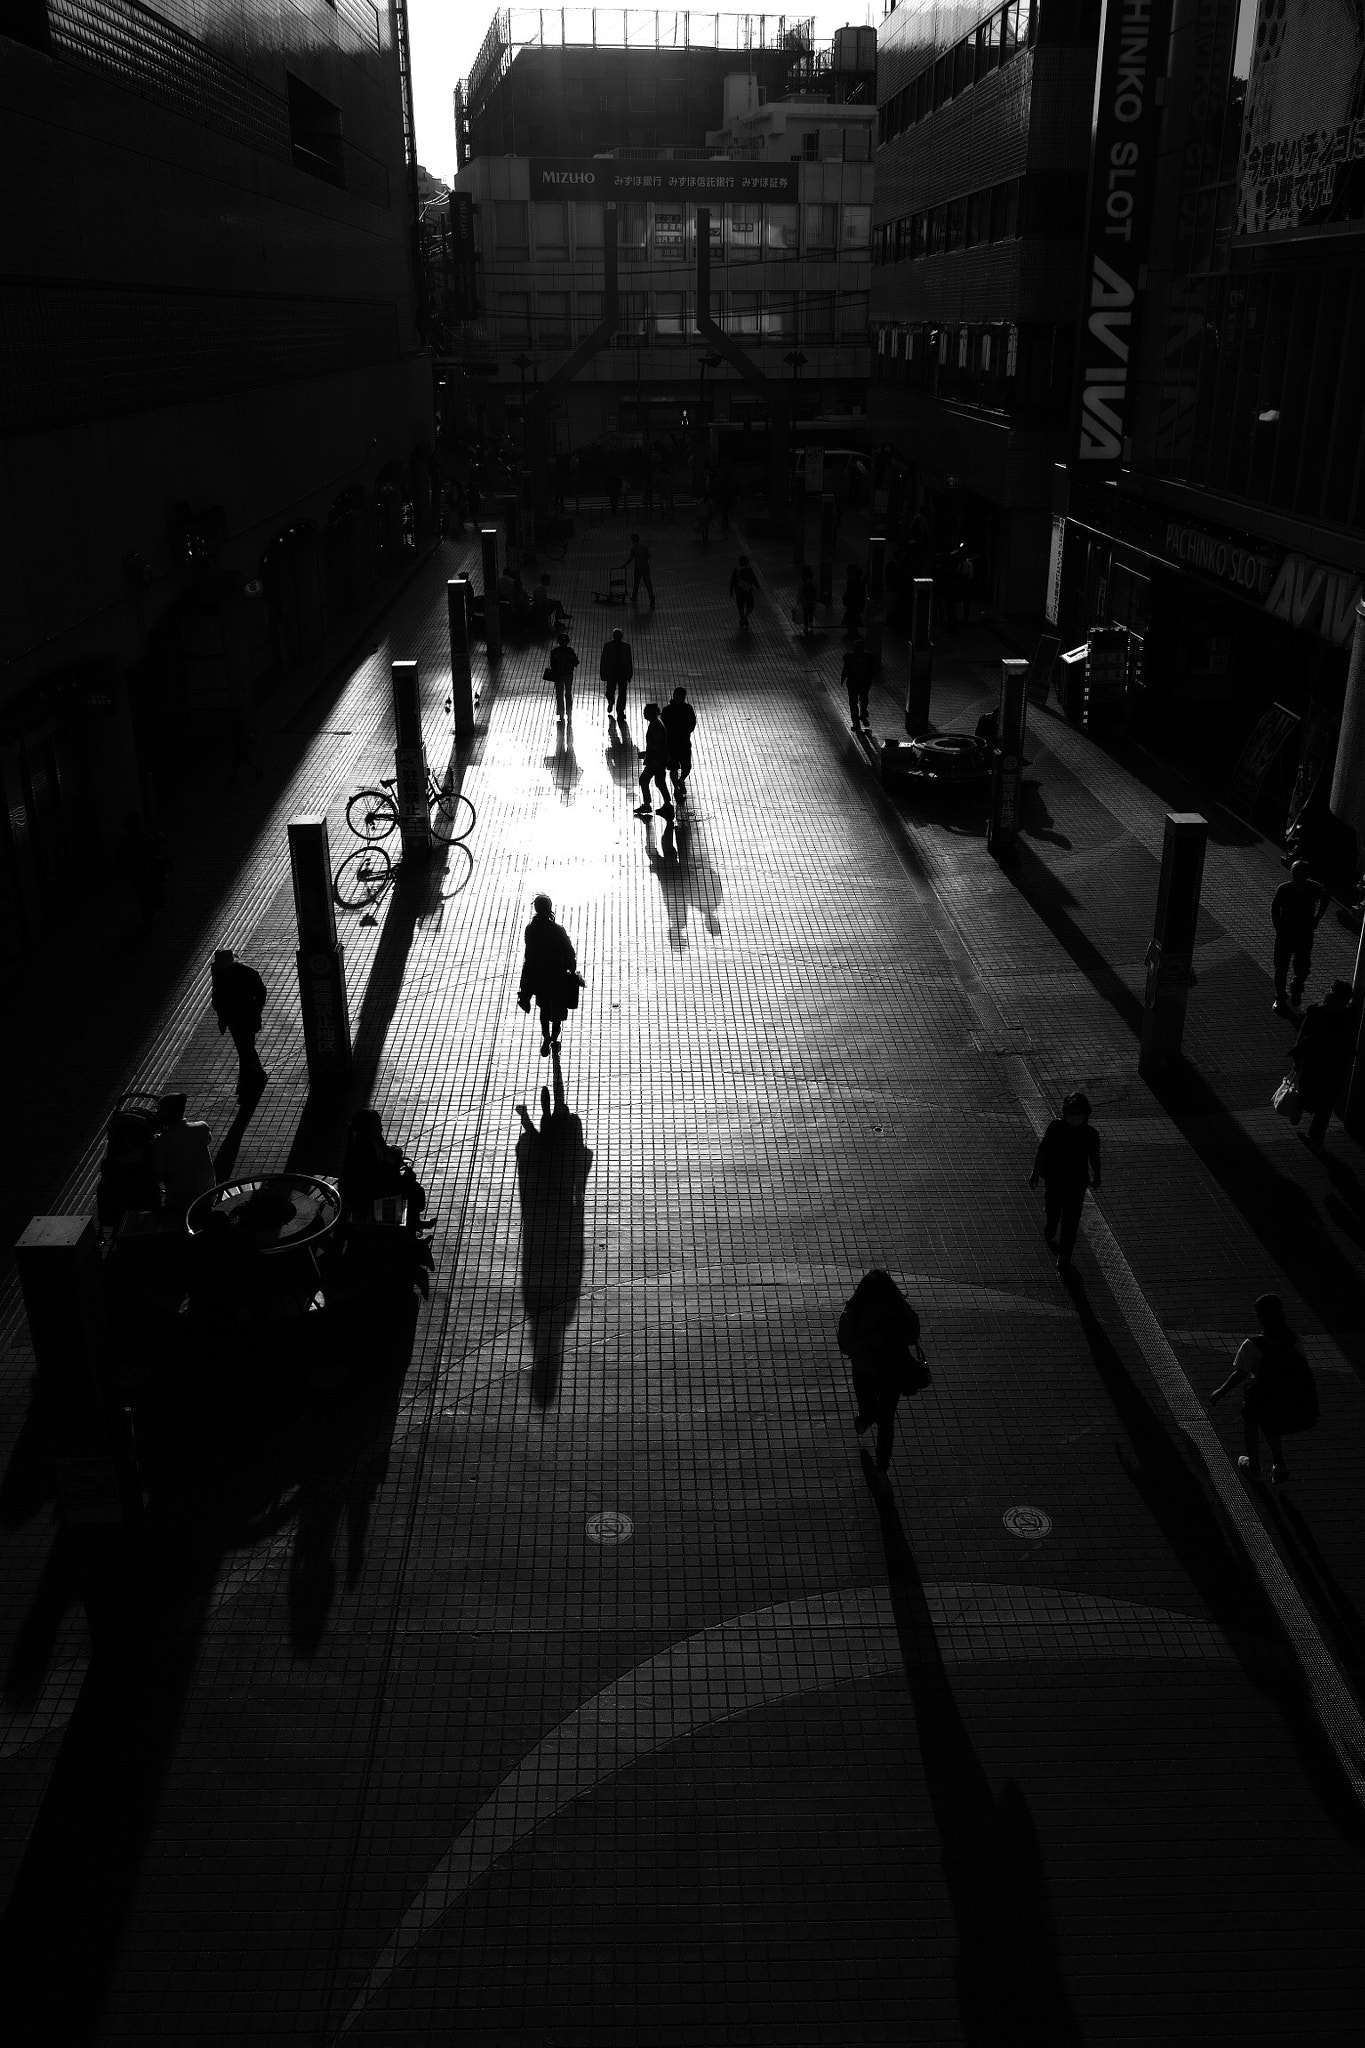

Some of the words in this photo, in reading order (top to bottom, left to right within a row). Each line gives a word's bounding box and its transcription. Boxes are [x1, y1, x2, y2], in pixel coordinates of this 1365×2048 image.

[541, 171, 596, 184] MIZUHO
[614, 175, 662, 187] みずほ銀行
[668, 175, 734, 188] みずほ信託銀行
[741, 176, 789, 189] みずほ証券
[1103, 141, 1140, 244] SLOT
[1078, 254, 1136, 461] AVIVA
[1165, 522, 1228, 577] PACHINKO
[1229, 547, 1268, 592] SLOT
